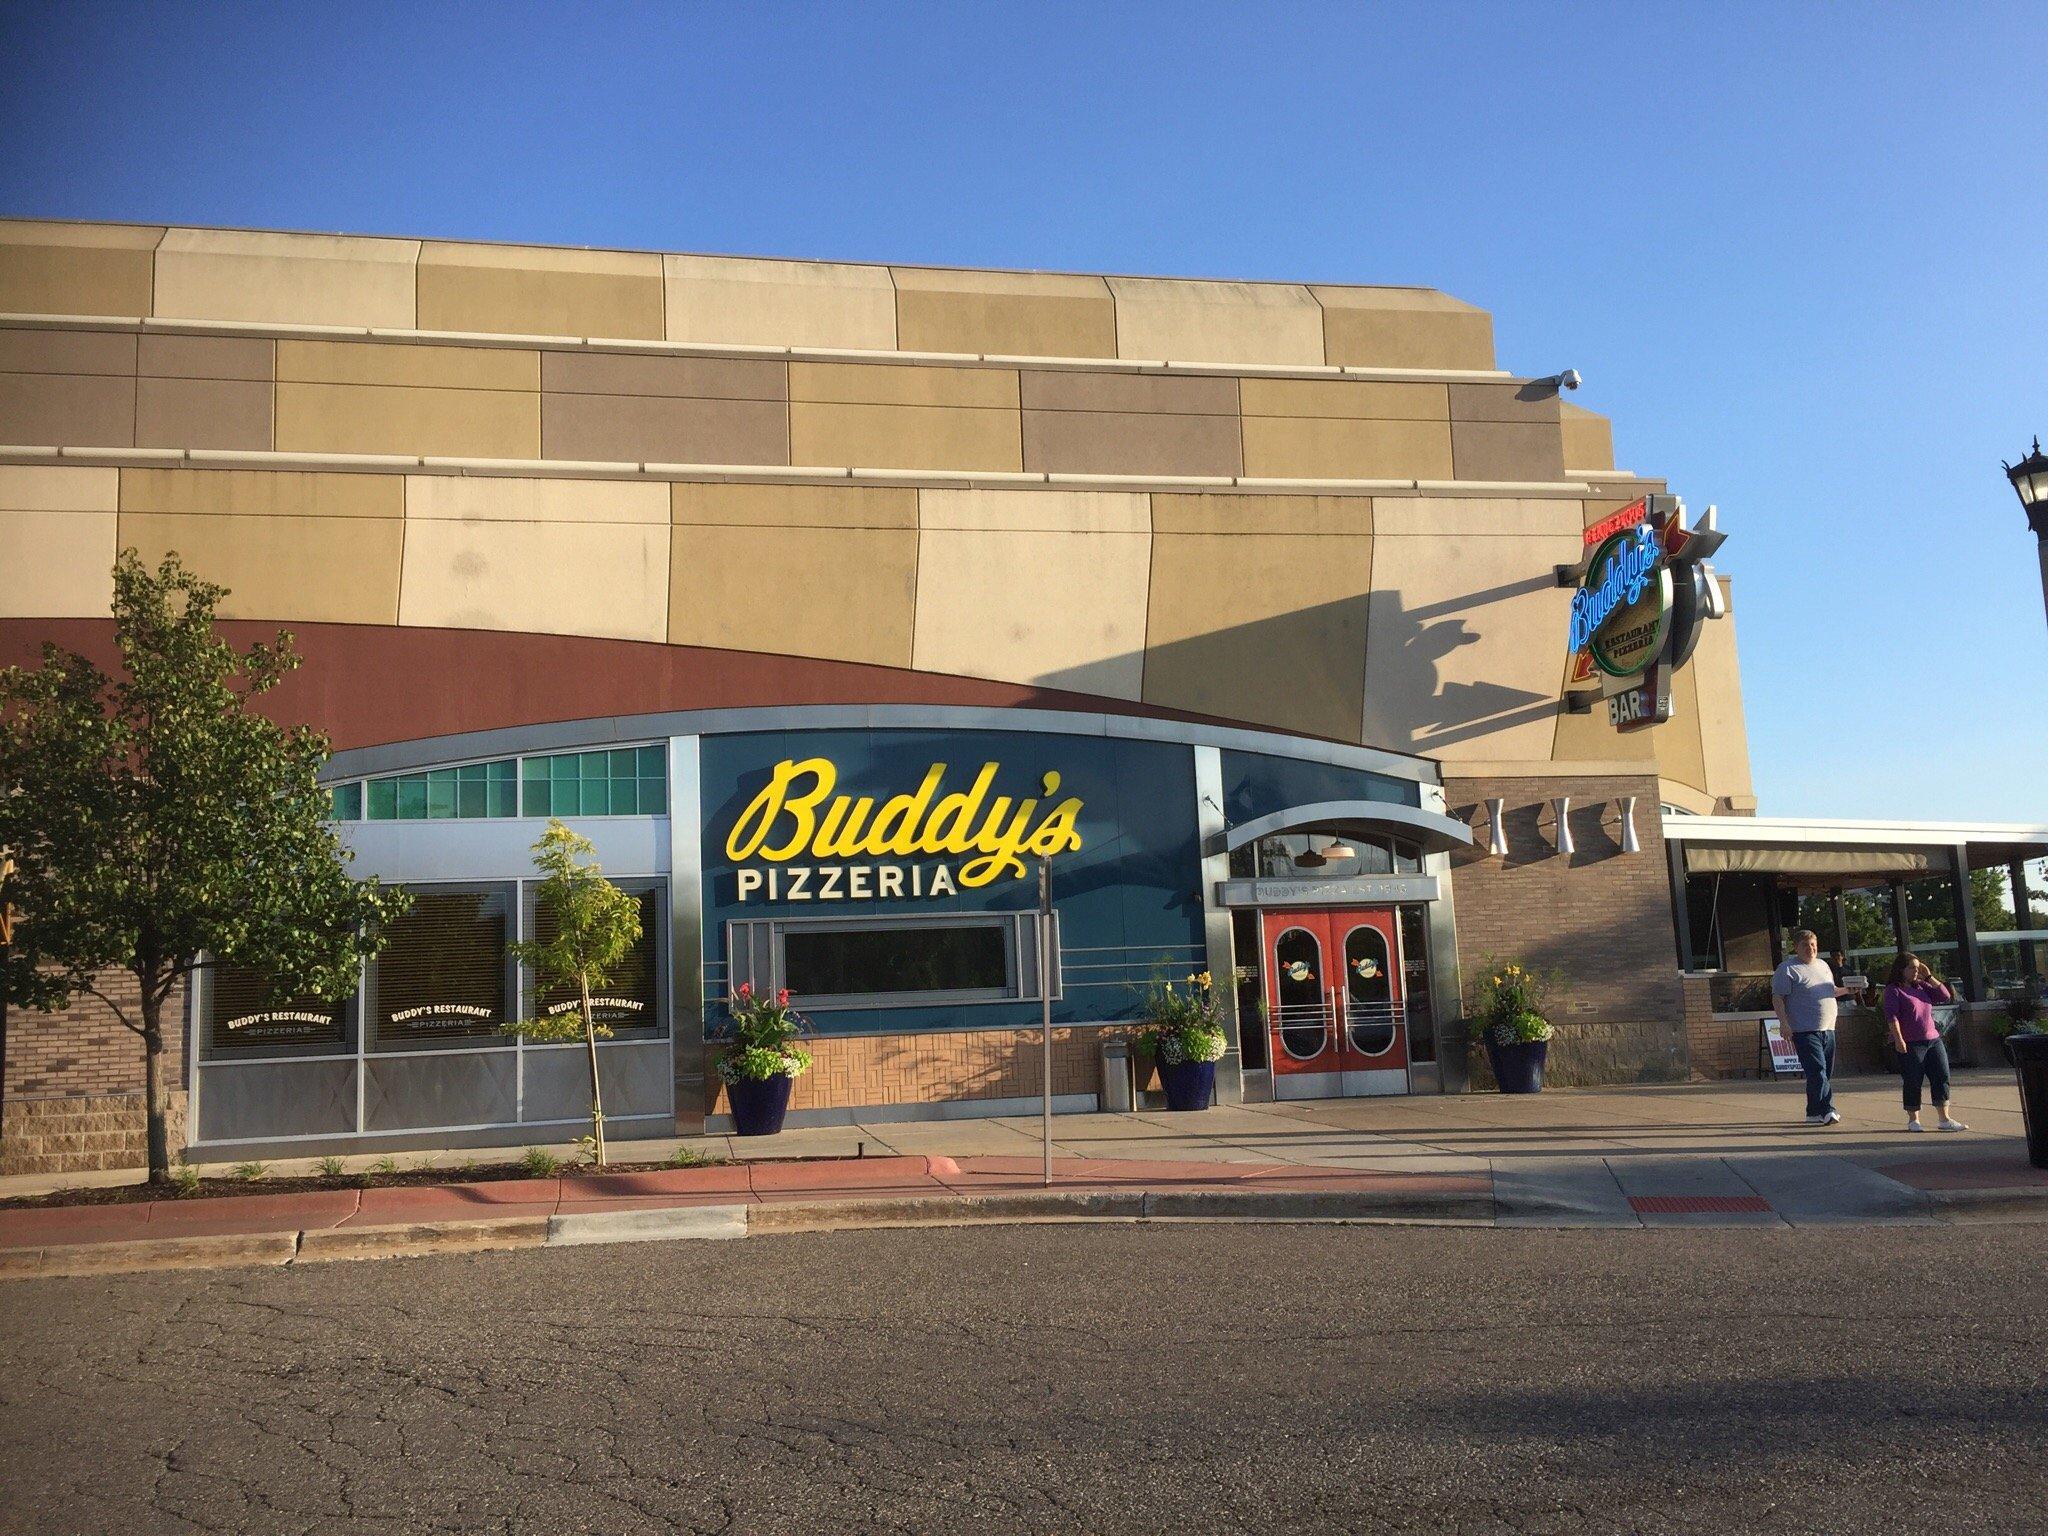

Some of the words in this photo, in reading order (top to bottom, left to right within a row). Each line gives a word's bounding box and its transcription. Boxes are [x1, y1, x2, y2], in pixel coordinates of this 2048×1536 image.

[1569, 524, 1660, 655] Buddy's
[1609, 690, 1641, 726] BAR
[726, 757, 1084, 887] Buddy's
[738, 864, 957, 901] PIZZERIA
[391, 1005, 432, 1022] BUDDY'S
[434, 1004, 492, 1018] RESTAURANT
[589, 997, 644, 1011] RESTAURANT
[227, 1013, 270, 1029] BUDDY'S
[272, 1012, 333, 1025] RESTAURANT
[419, 1019, 464, 1028] PIZZERIA
[256, 1026, 303, 1035] PIZZERIA
